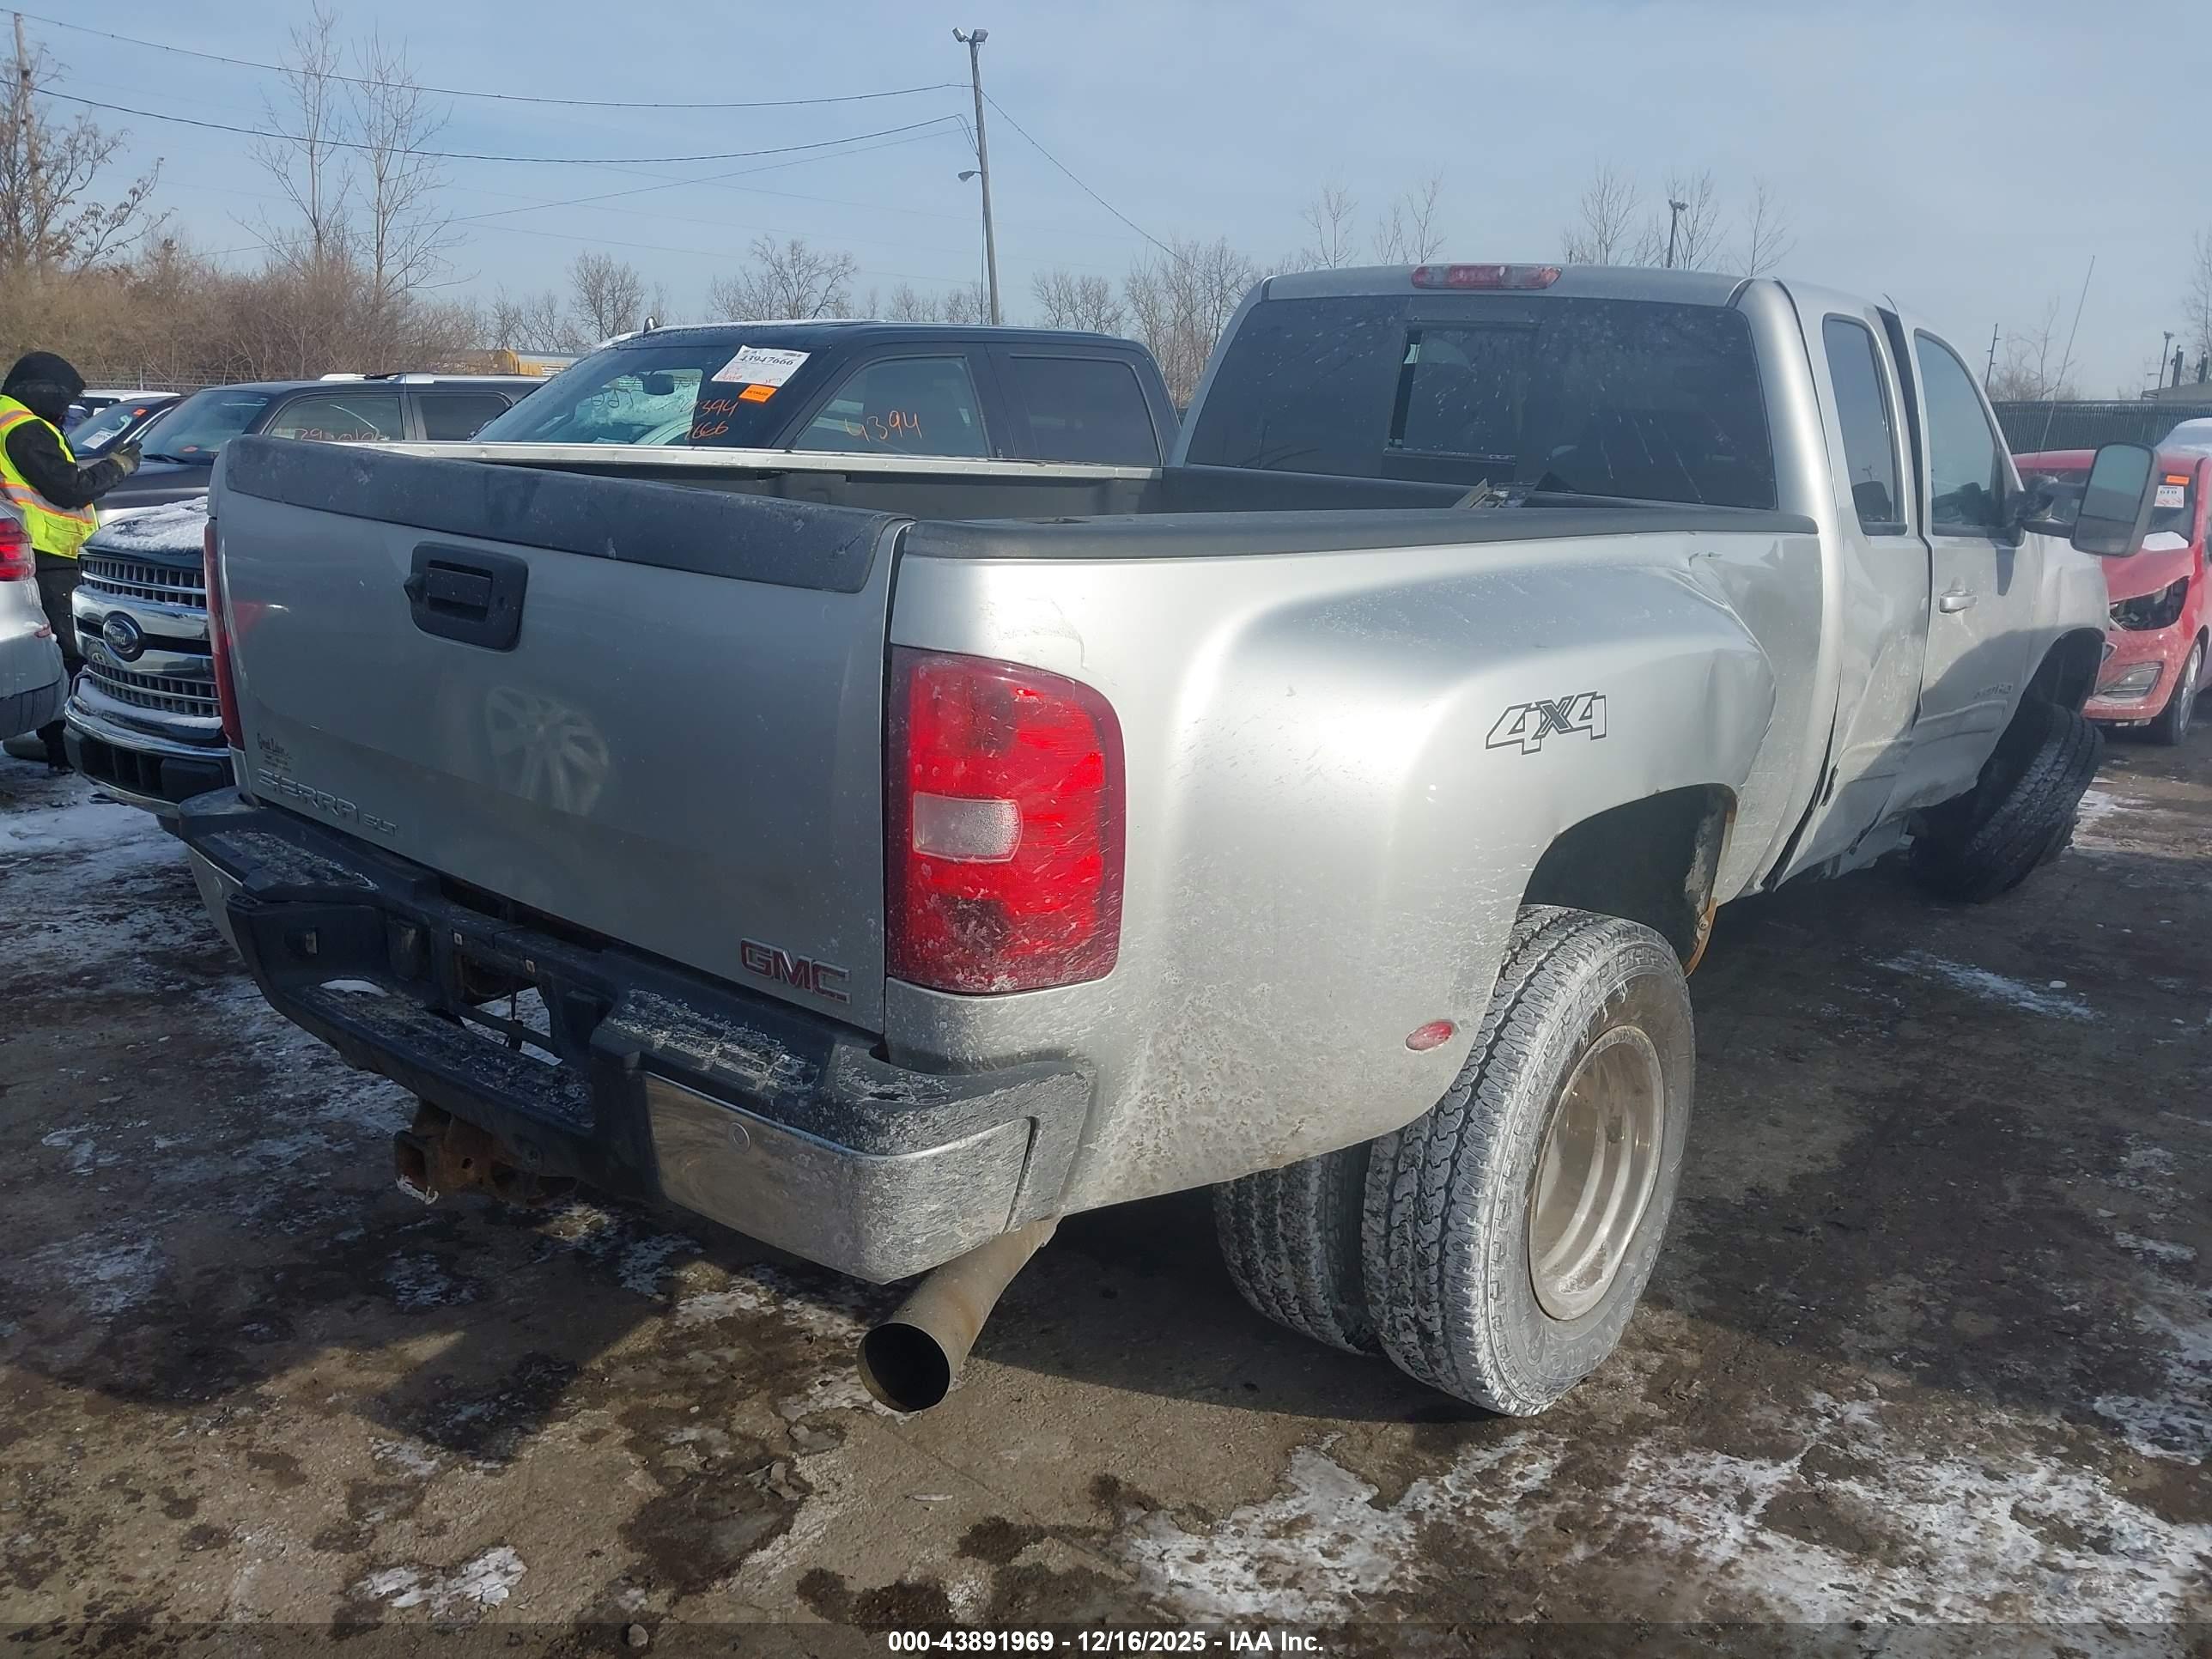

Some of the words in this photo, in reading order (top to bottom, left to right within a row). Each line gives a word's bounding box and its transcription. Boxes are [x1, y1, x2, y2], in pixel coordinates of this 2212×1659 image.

[739, 353, 794, 366] 43947666
[845, 410, 922, 443] 4394
[258, 768, 359, 824] SIERRA
[363, 812, 398, 836] SLT
[740, 938, 852, 1004] GMC
